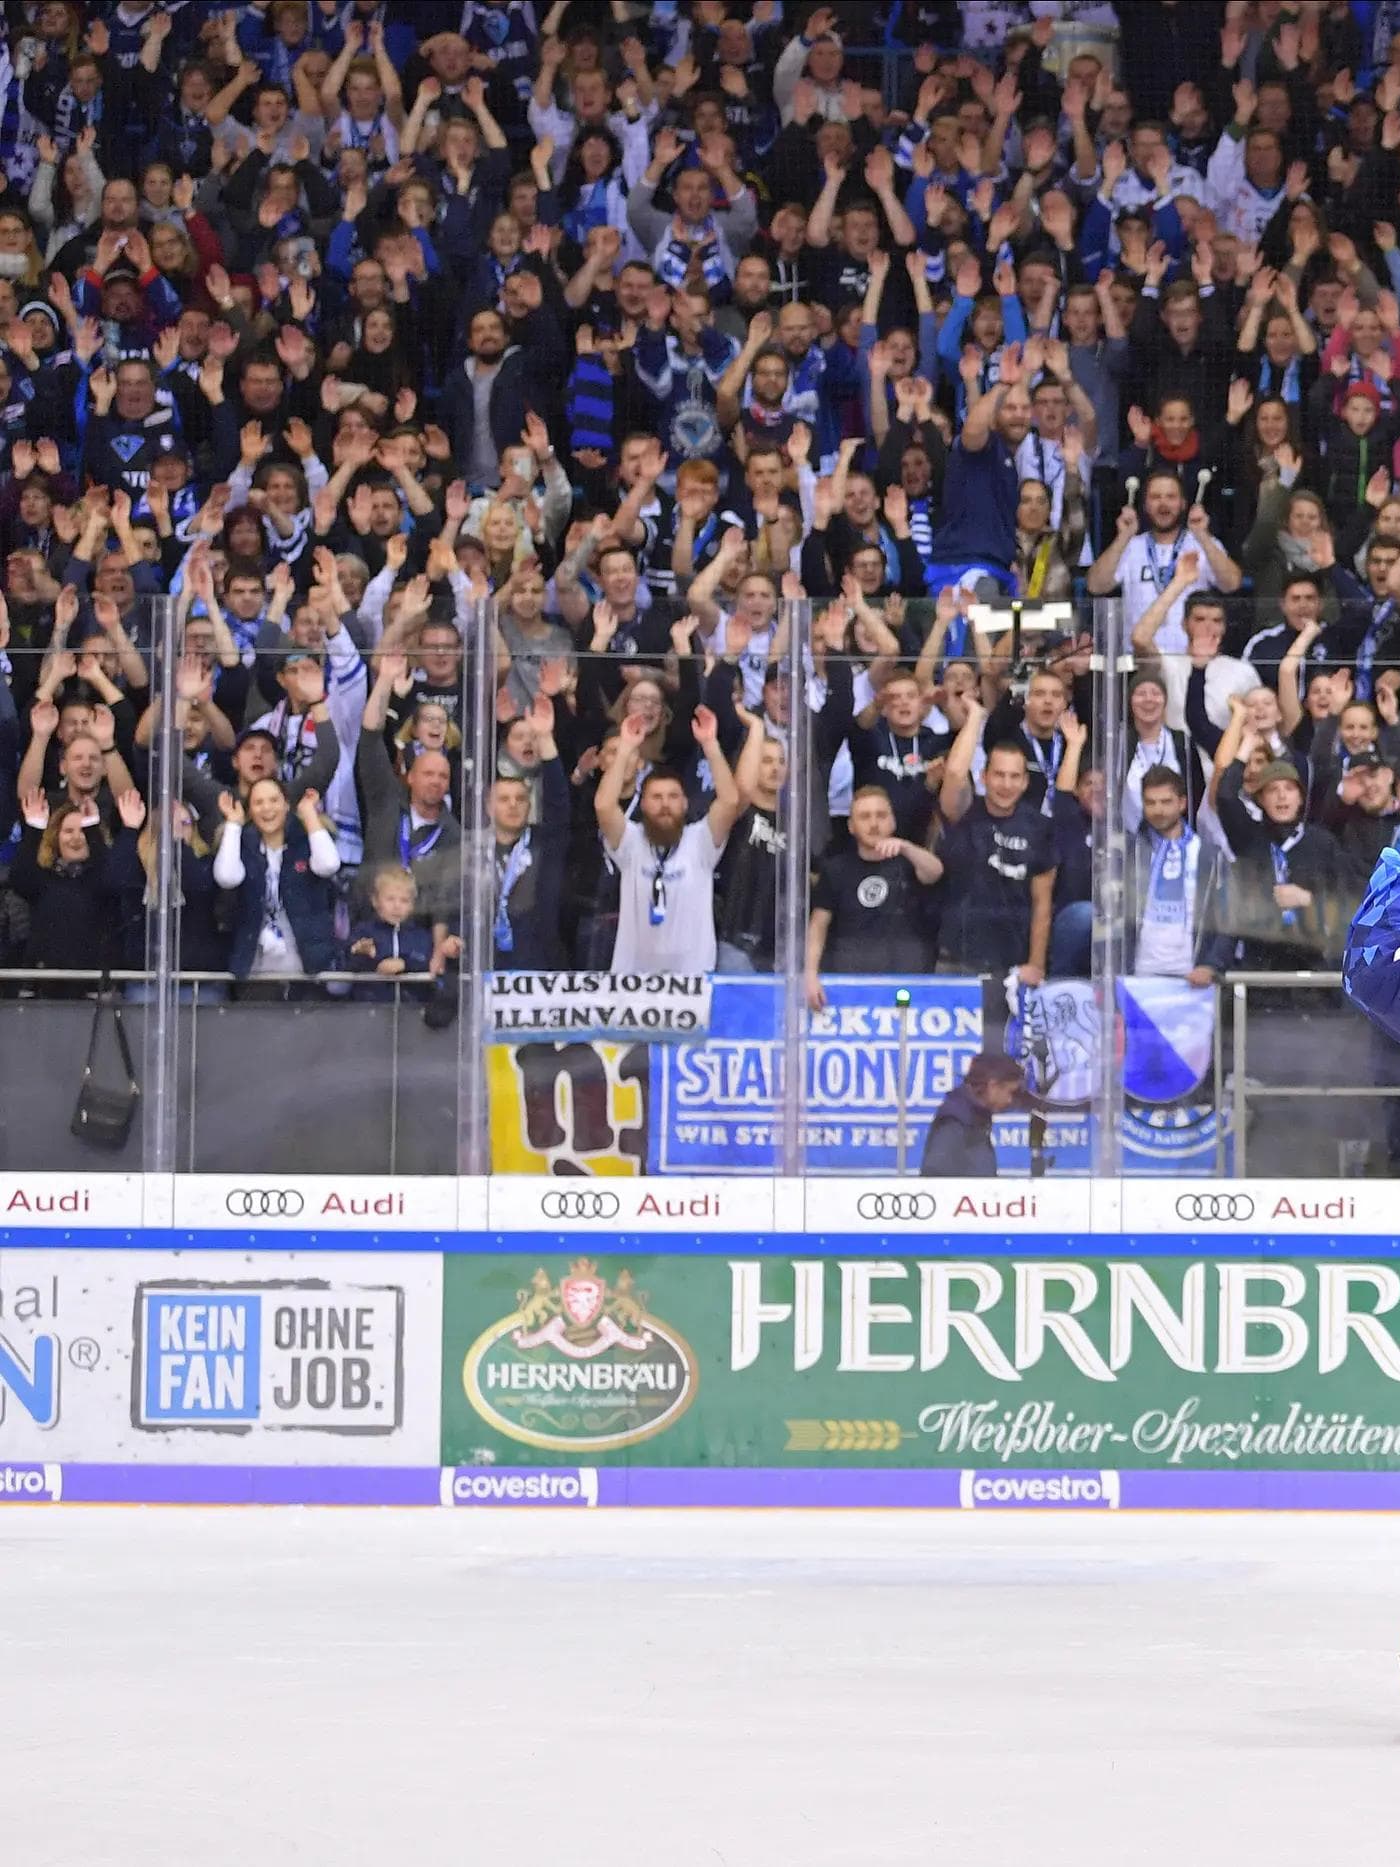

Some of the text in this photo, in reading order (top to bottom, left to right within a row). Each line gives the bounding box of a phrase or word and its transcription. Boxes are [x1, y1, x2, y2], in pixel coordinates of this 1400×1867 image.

[491, 974, 703, 995] INGOLSTADT
[494, 1006, 698, 1030] GIOVANETTI
[801, 1005, 982, 1036] EKTION
[675, 1125, 729, 1146] WIR
[6, 1189, 91, 1213] Audi
[321, 1192, 406, 1216] Audi
[636, 1192, 722, 1217] Audi
[953, 1195, 1038, 1219] Audi
[1272, 1196, 1357, 1220] Audi
[159, 1305, 374, 1351] KEIN OHNE
[159, 1355, 383, 1409] FAN JOB.
[487, 1362, 677, 1392] HERRNBRÄU
[454, 1473, 580, 1500] covestro
[973, 1474, 1100, 1501] covestro
